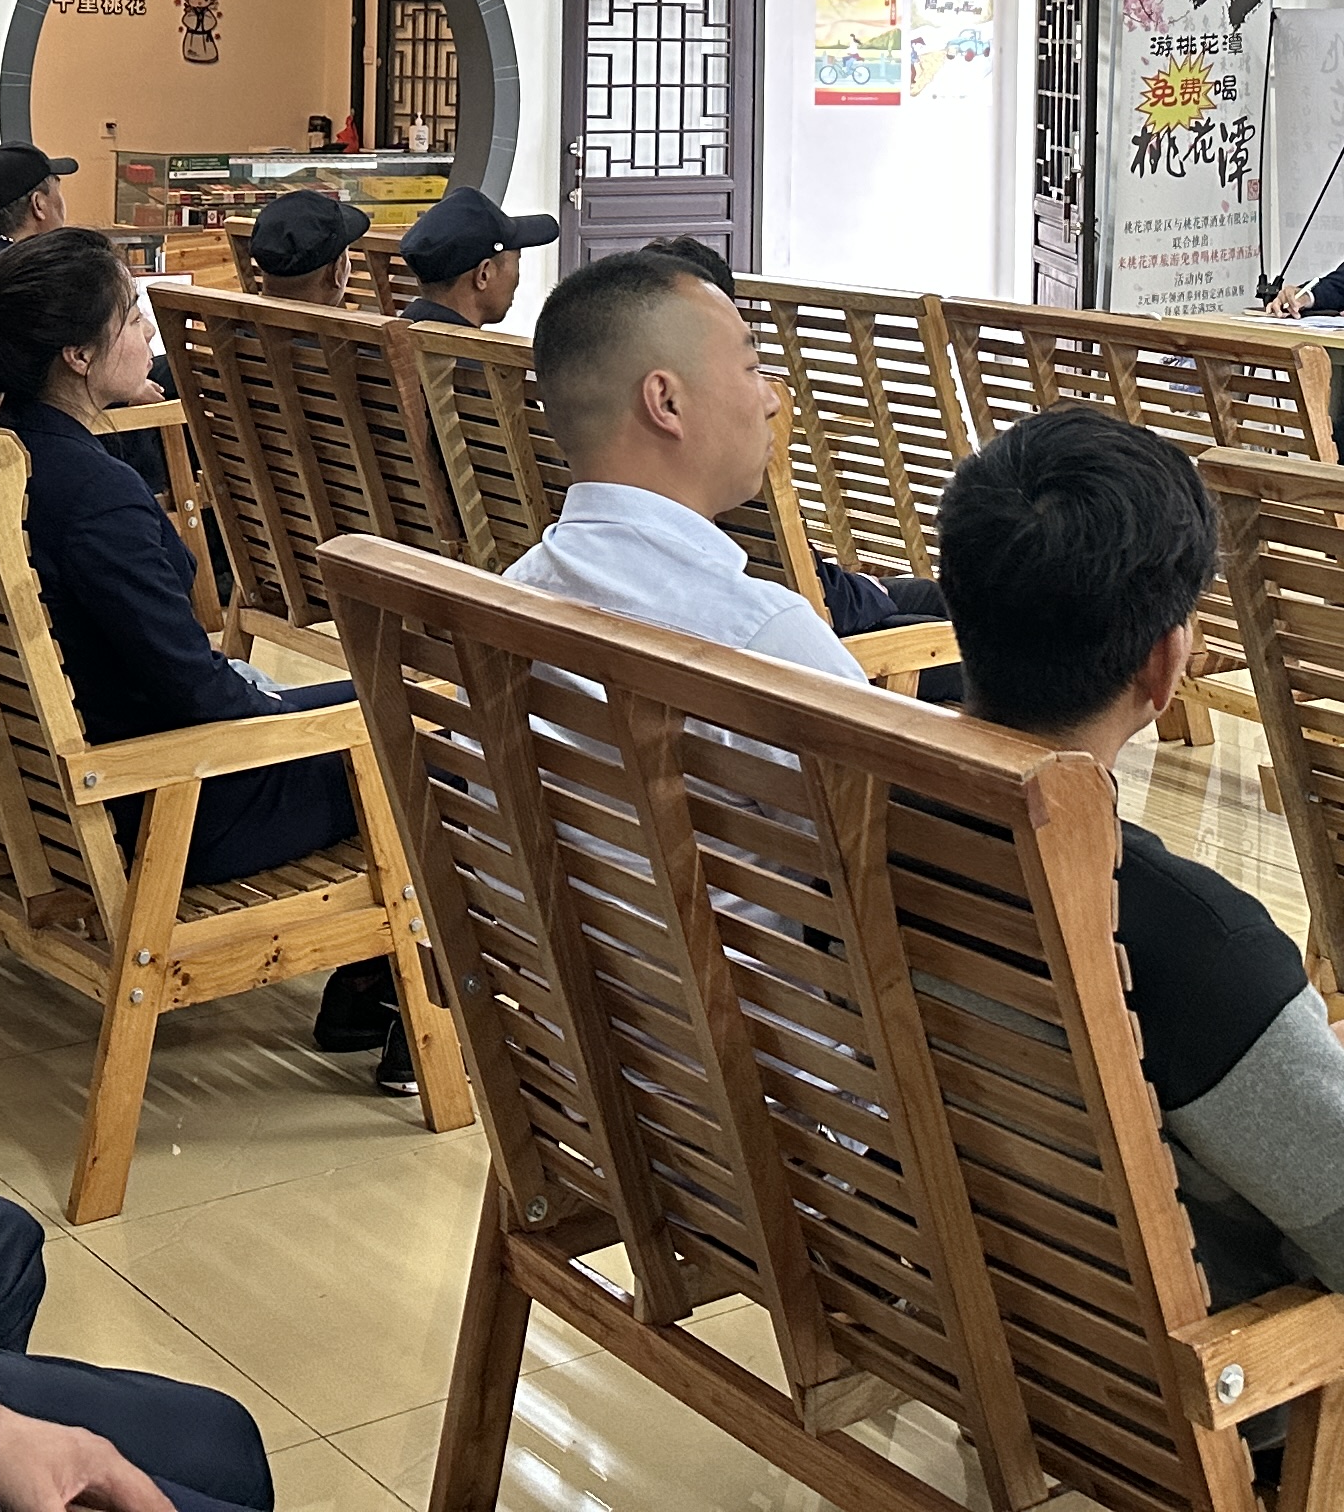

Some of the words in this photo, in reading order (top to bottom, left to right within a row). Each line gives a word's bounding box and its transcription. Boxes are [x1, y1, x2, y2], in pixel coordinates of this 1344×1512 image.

[1149, 33, 1244, 57] 游桃花潭
[1148, 75, 1202, 108] 免费
[1213, 74, 1238, 102] 喝
[1130, 115, 1256, 204] 桃花潭
